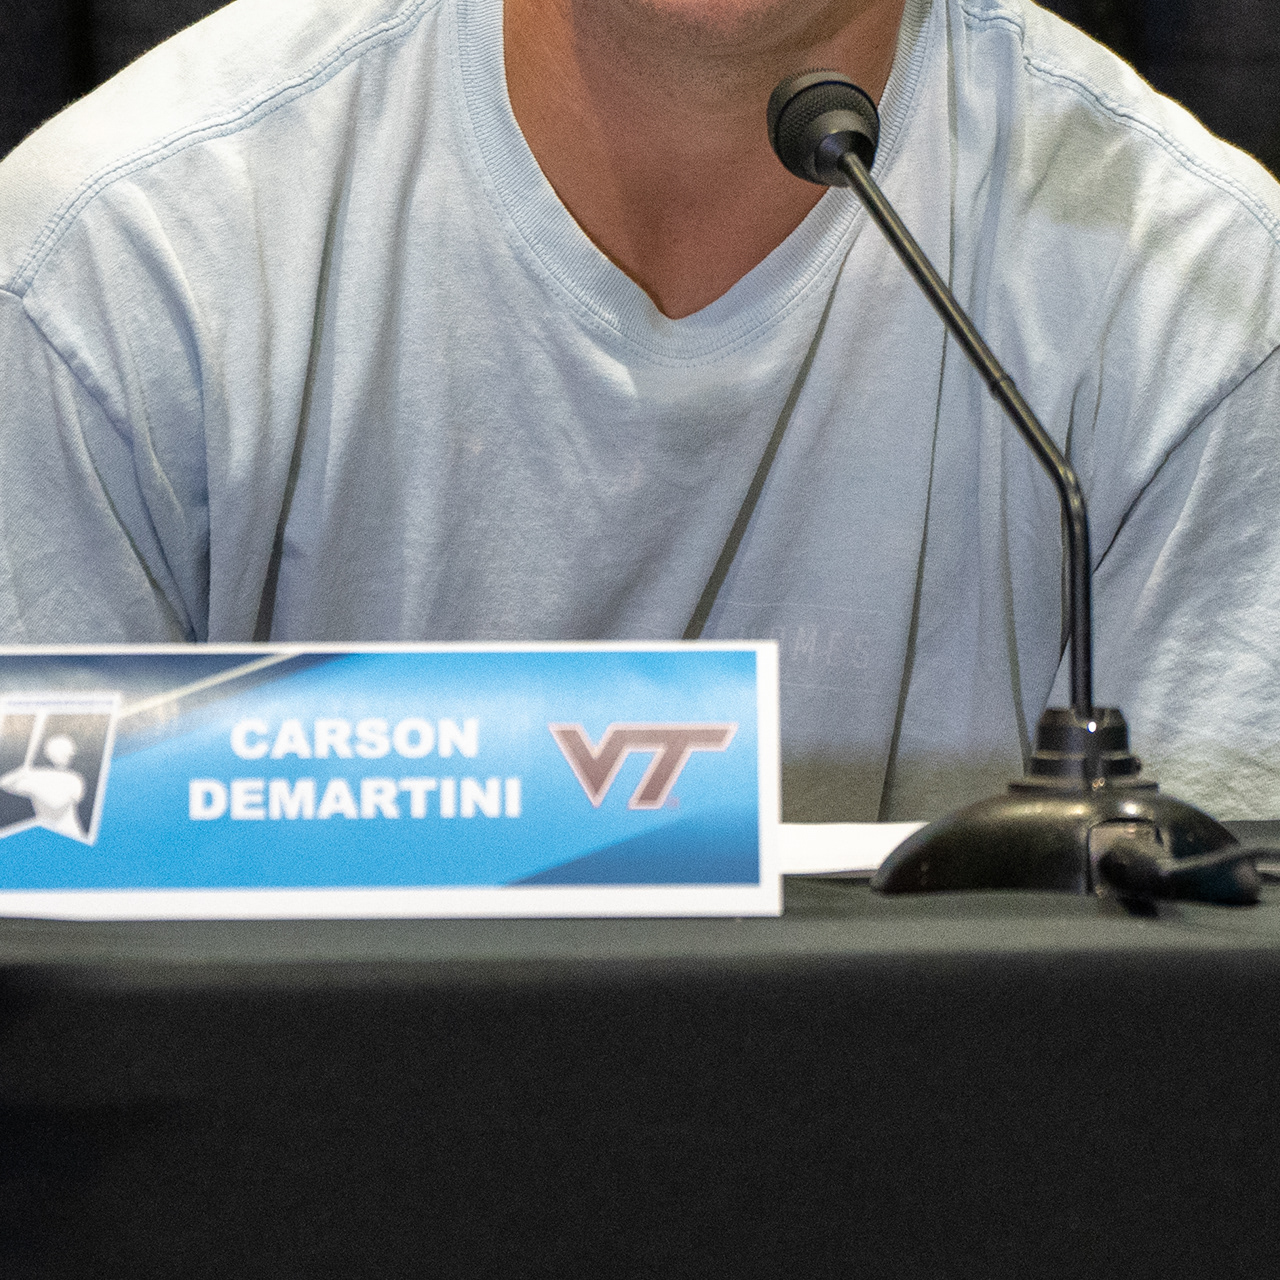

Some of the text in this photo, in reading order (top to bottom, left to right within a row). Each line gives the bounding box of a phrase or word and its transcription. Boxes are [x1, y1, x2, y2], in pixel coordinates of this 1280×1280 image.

[230, 718, 480, 759] CARSON
[548, 722, 738, 810] VT
[189, 777, 520, 820] DEMARTINI
